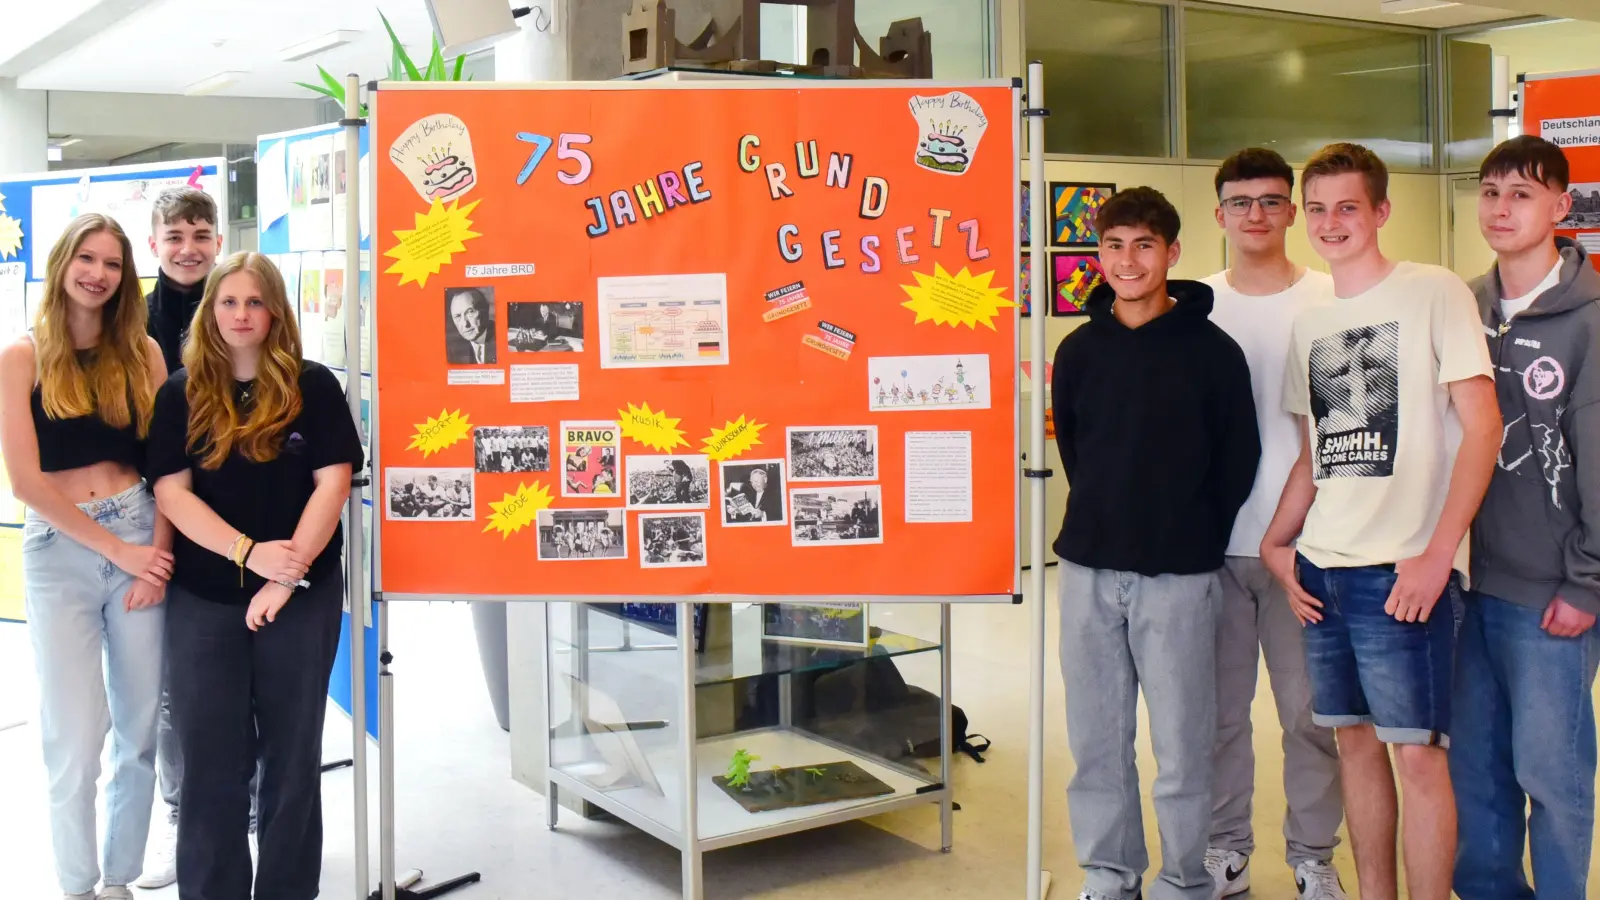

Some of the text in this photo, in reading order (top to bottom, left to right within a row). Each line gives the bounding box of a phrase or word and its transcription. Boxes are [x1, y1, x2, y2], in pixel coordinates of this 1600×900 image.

[909, 92, 988, 128] Happy Birthday
[390, 117, 466, 164] Happy Birthday
[515, 131, 712, 239] 75 JAHRE
[737, 133, 891, 220] GRUND
[776, 207, 991, 275] GESETZ
[465, 263, 535, 276] 75 Jahre BRD
[767, 282, 802, 300] WIR FEIERN
[778, 292, 805, 306] 75 JAHRE
[766, 301, 808, 321] GRUNDGESETZ
[821, 321, 855, 341] WIR FEIERN
[823, 333, 851, 349] 75 JAHRE
[805, 337, 847, 359] GRUNDGESETZ
[420, 416, 453, 445] SPORT
[631, 414, 664, 430] MUSIK
[568, 430, 614, 442] BRAVO
[817, 430, 863, 444] Million
[1321, 451, 1389, 465] NO ONE CARES
[500, 493, 529, 520] MODE
